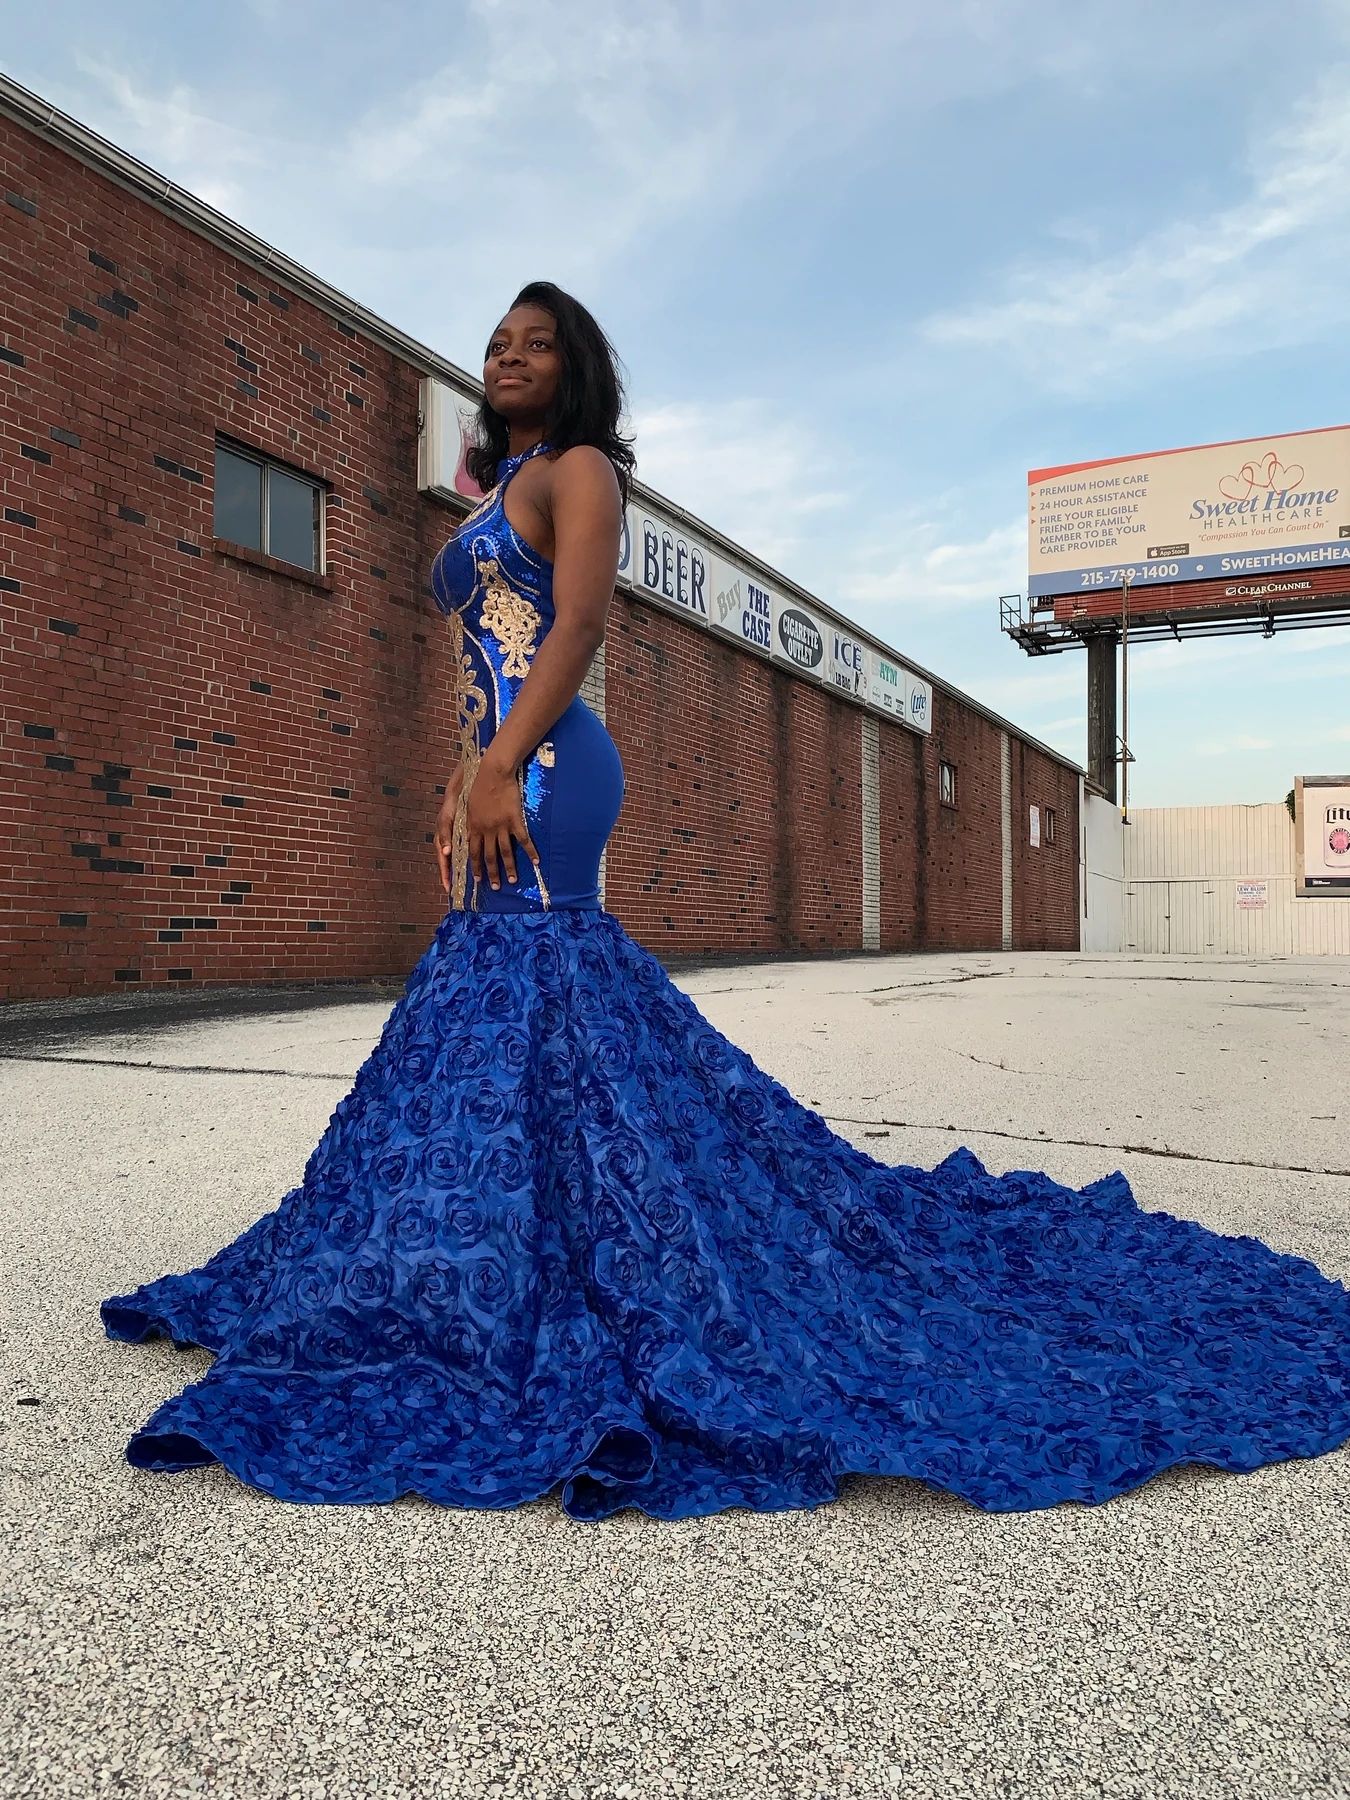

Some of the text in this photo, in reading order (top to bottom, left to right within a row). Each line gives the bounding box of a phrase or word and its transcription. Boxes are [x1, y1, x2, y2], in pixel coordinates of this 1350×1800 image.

[1039, 474, 1150, 497] PREMIUM HOME CARE
[1040, 488, 1148, 510] 24 HOUR ASSISTANCE
[1188, 488, 1339, 520] Sweet Home
[1039, 504, 1139, 525] HIRE YOUR ELIGIBLE
[1039, 515, 1133, 534] FRIEND OR FAMILY
[1203, 506, 1324, 529] HEALTHCARE
[1039, 524, 1146, 545] MEMBER TO BE YOUR
[1250, 528, 1266, 537] You
[1268, 526, 1284, 535] Can
[1286, 523, 1311, 533] Count
[1039, 538, 1118, 555] CARE PROVIDER
[643, 519, 706, 614] BEER
[1080, 563, 1179, 586] 215-739-1400
[717, 579, 770, 623] Buy THE
[742, 610, 771, 648] CASE
[782, 614, 819, 650] CIGARETTE
[788, 637, 813, 666] OUTLET
[834, 631, 862, 672] ICE
[880, 661, 898, 687] ATM
[912, 694, 927, 713] Lite
